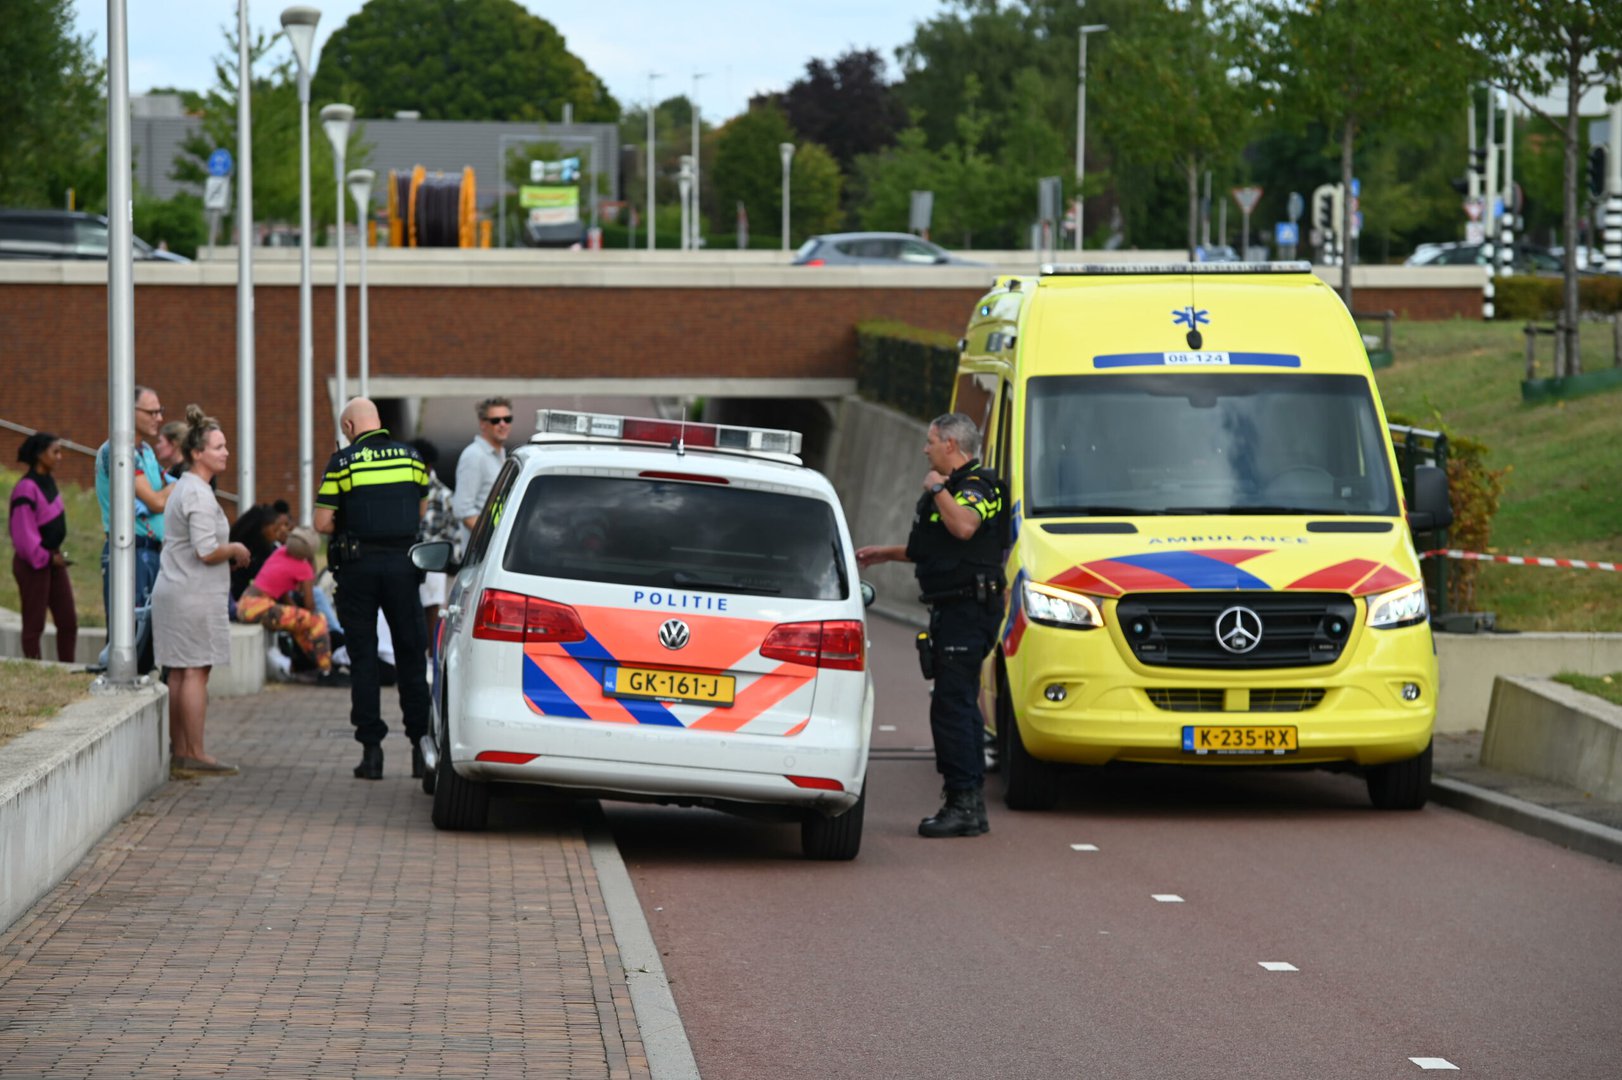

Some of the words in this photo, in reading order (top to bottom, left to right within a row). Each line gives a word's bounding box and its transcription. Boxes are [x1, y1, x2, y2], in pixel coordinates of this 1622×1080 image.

[1168, 354, 1223, 363] 08-124
[1149, 535, 1309, 545] AMBULANCE
[634, 591, 728, 611] POLITIE
[629, 672, 718, 697] GK-161-J
[1201, 730, 1289, 746] K-235-RX
